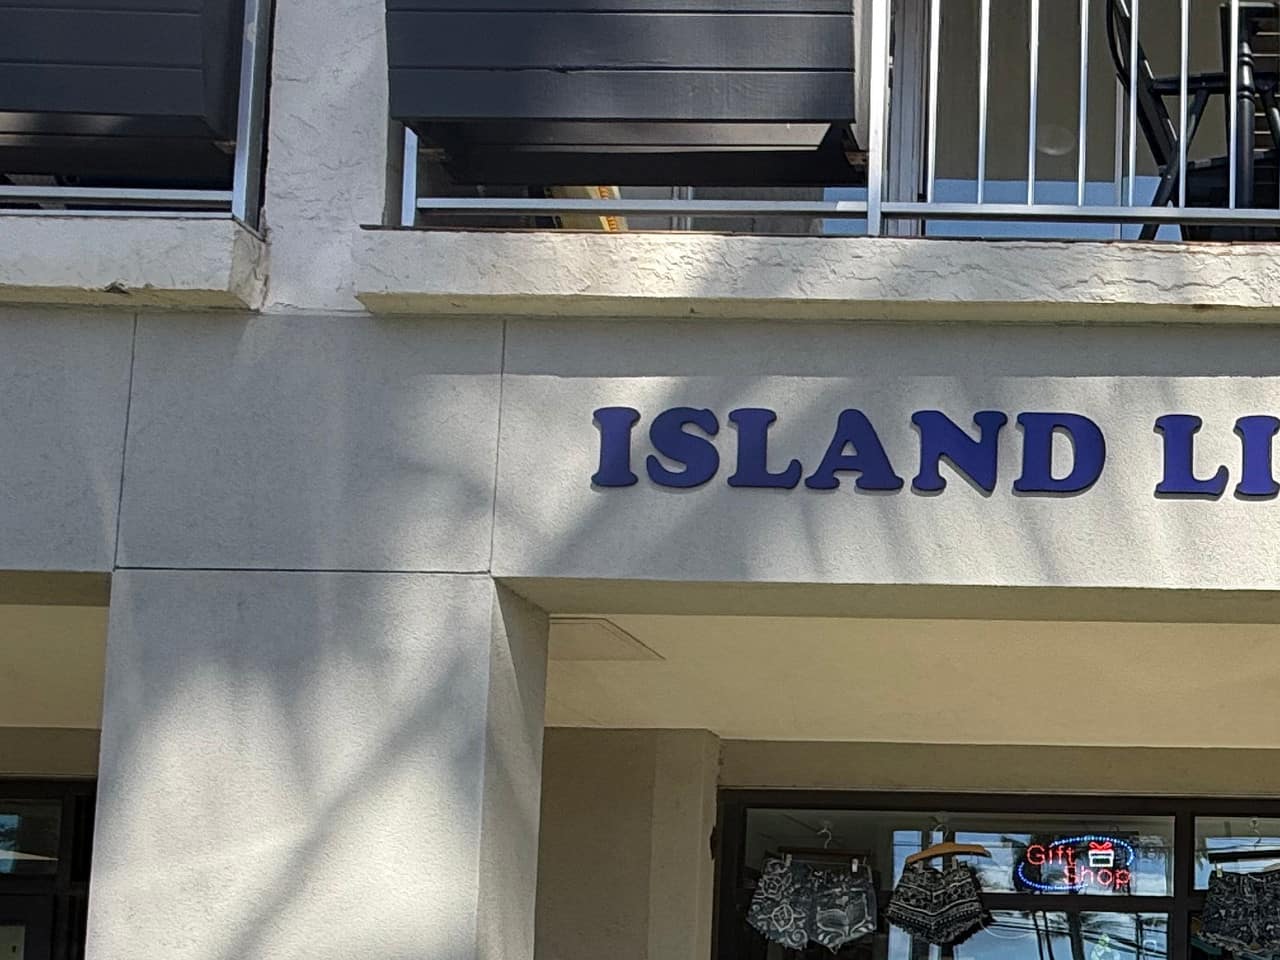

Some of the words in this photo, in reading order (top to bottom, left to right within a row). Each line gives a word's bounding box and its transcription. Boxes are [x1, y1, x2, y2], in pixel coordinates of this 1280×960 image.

[593, 406, 1106, 497] ISLAND
[1026, 844, 1075, 865] Gift
[1064, 864, 1131, 889] Shop
